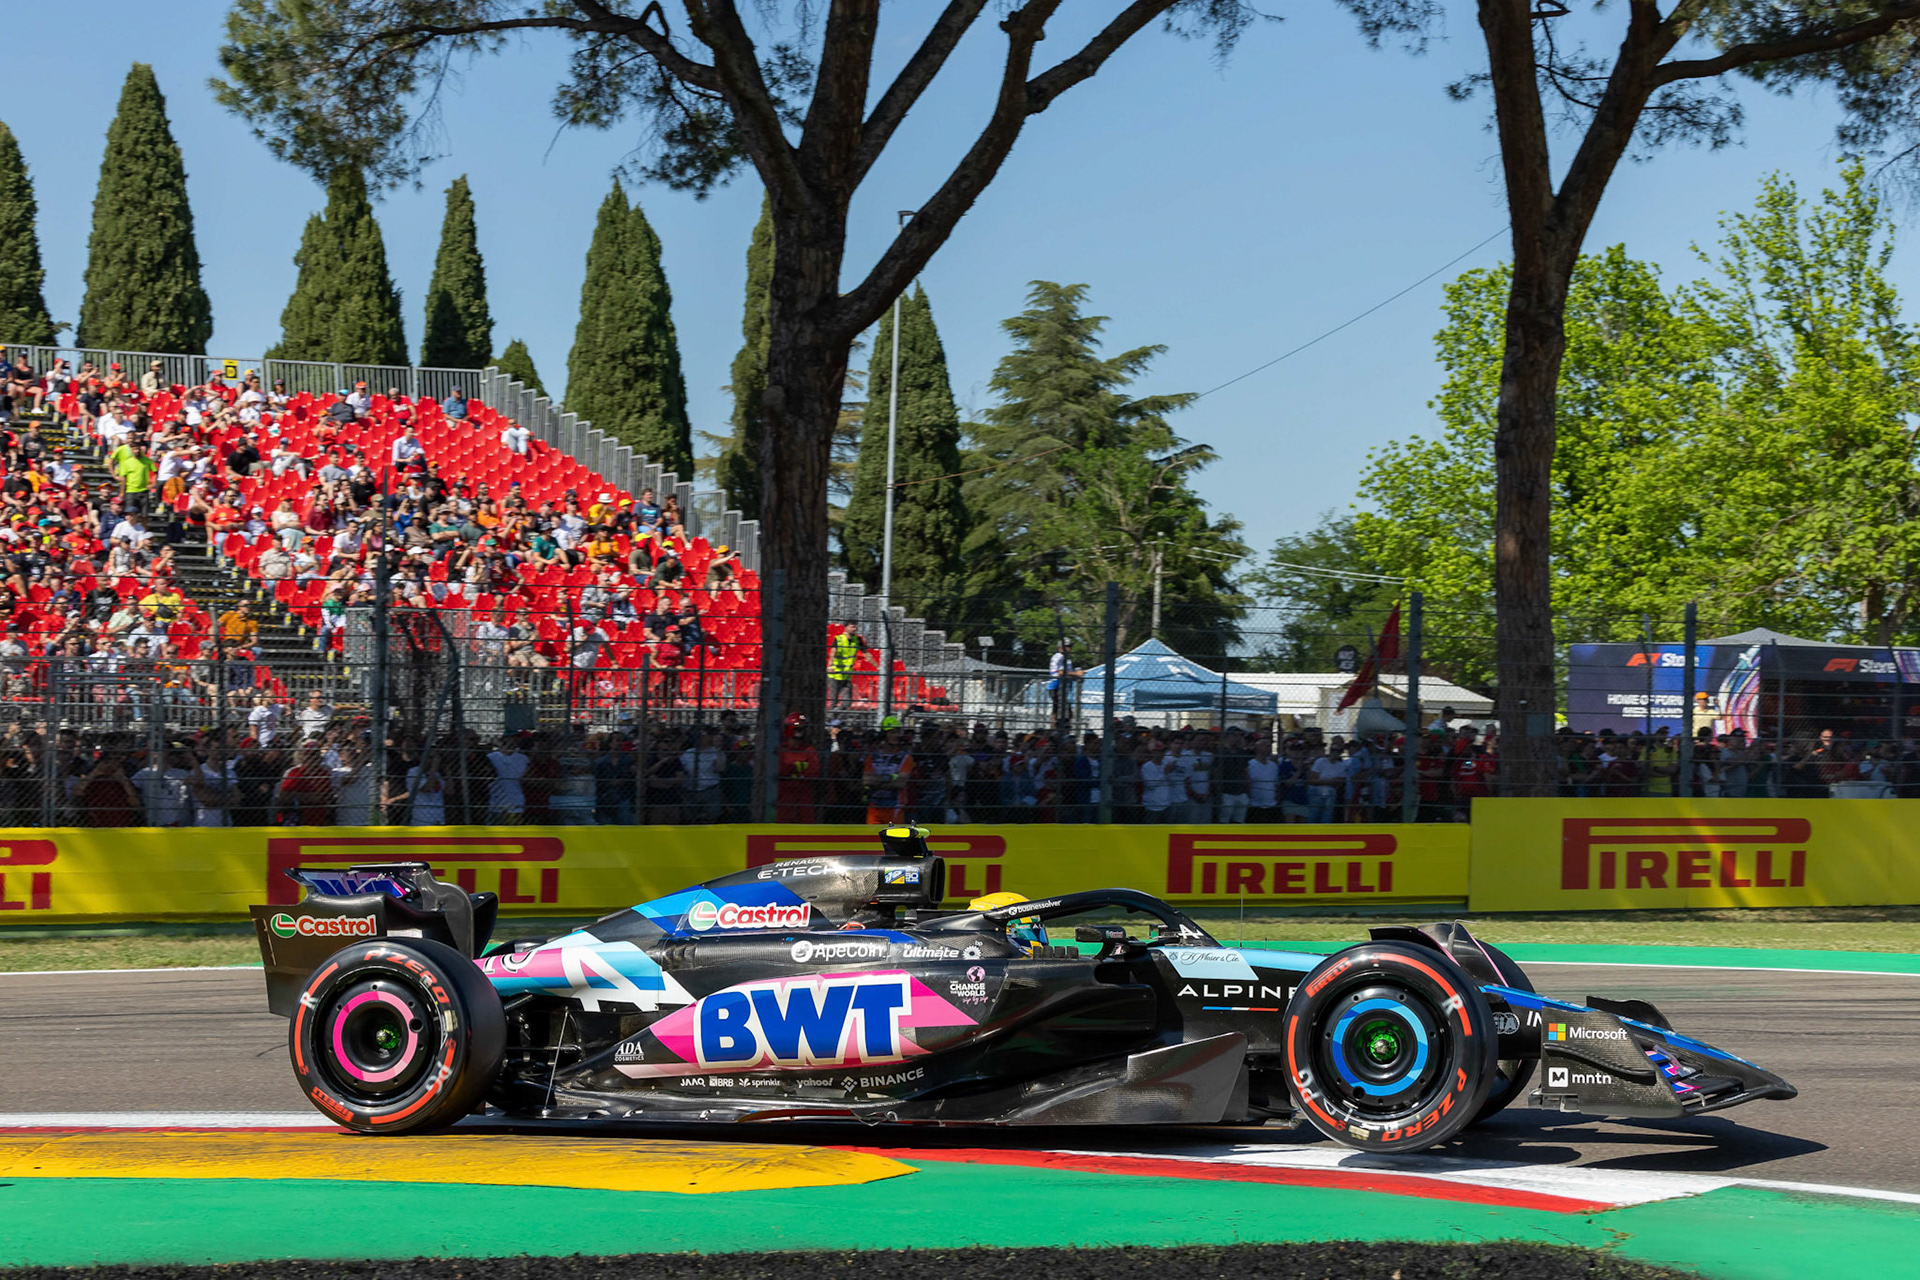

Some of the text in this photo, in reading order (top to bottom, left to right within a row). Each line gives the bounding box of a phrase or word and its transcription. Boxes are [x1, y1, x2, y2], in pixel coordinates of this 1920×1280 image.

[1859, 659, 1897, 673] Store
[1608, 694, 1639, 705] HOME
[1561, 818, 1811, 889] PIRELLI
[775, 858, 829, 868] RENAULT
[1166, 834, 1397, 894] PIRELLI
[718, 903, 810, 928] Castrol
[298, 916, 376, 935] Castrol
[814, 942, 886, 961] ApeCoin
[903, 945, 959, 960] ultimate
[1305, 956, 1353, 998] PIRELLI
[950, 983, 985, 991] CHANGE
[699, 982, 904, 1063] BWT
[1569, 1026, 1627, 1040] Microsoft
[615, 1041, 644, 1055] ADA
[717, 1078, 734, 1087] BRB
[752, 1079, 781, 1088] sprinklr
[796, 1077, 833, 1089] yahoo!
[860, 1067, 925, 1088] BINANCE
[1571, 1073, 1612, 1085] mntn
[1381, 1091, 1456, 1142] ZERO
